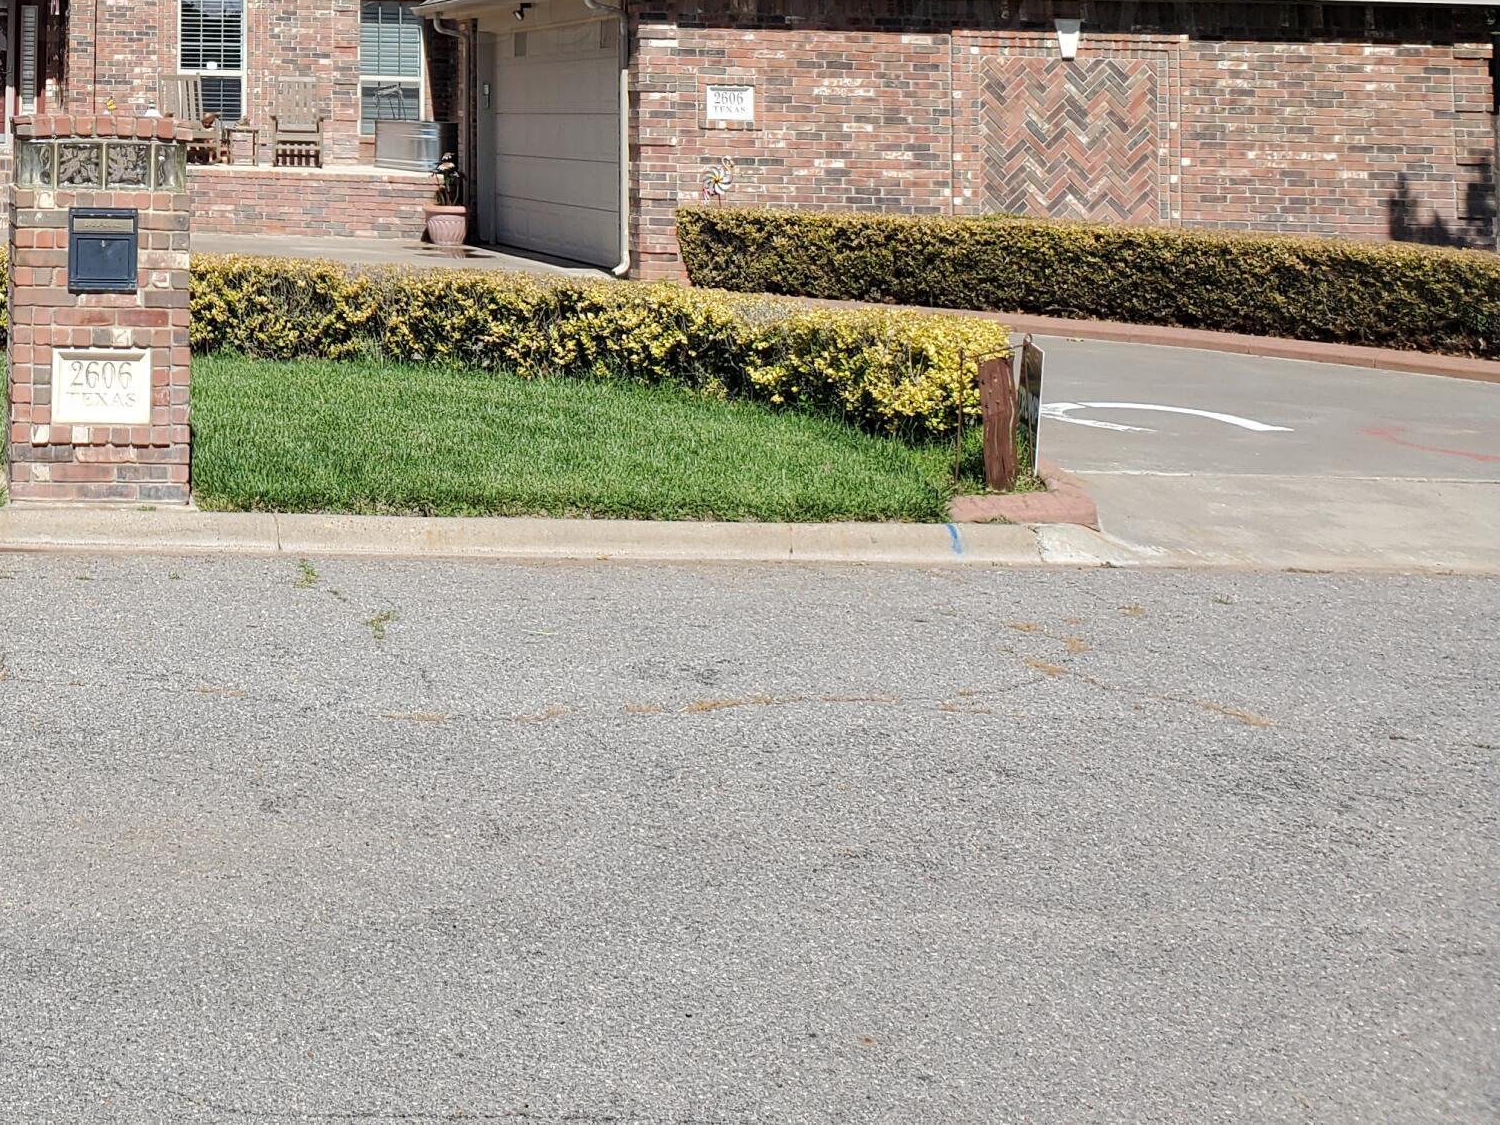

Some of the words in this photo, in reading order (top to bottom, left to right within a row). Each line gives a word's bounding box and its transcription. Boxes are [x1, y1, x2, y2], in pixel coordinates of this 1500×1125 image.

[714, 92, 743, 105] 2606
[713, 106, 746, 114] TEXAS
[70, 361, 132, 389] 2606
[66, 392, 136, 407] TEXAS
